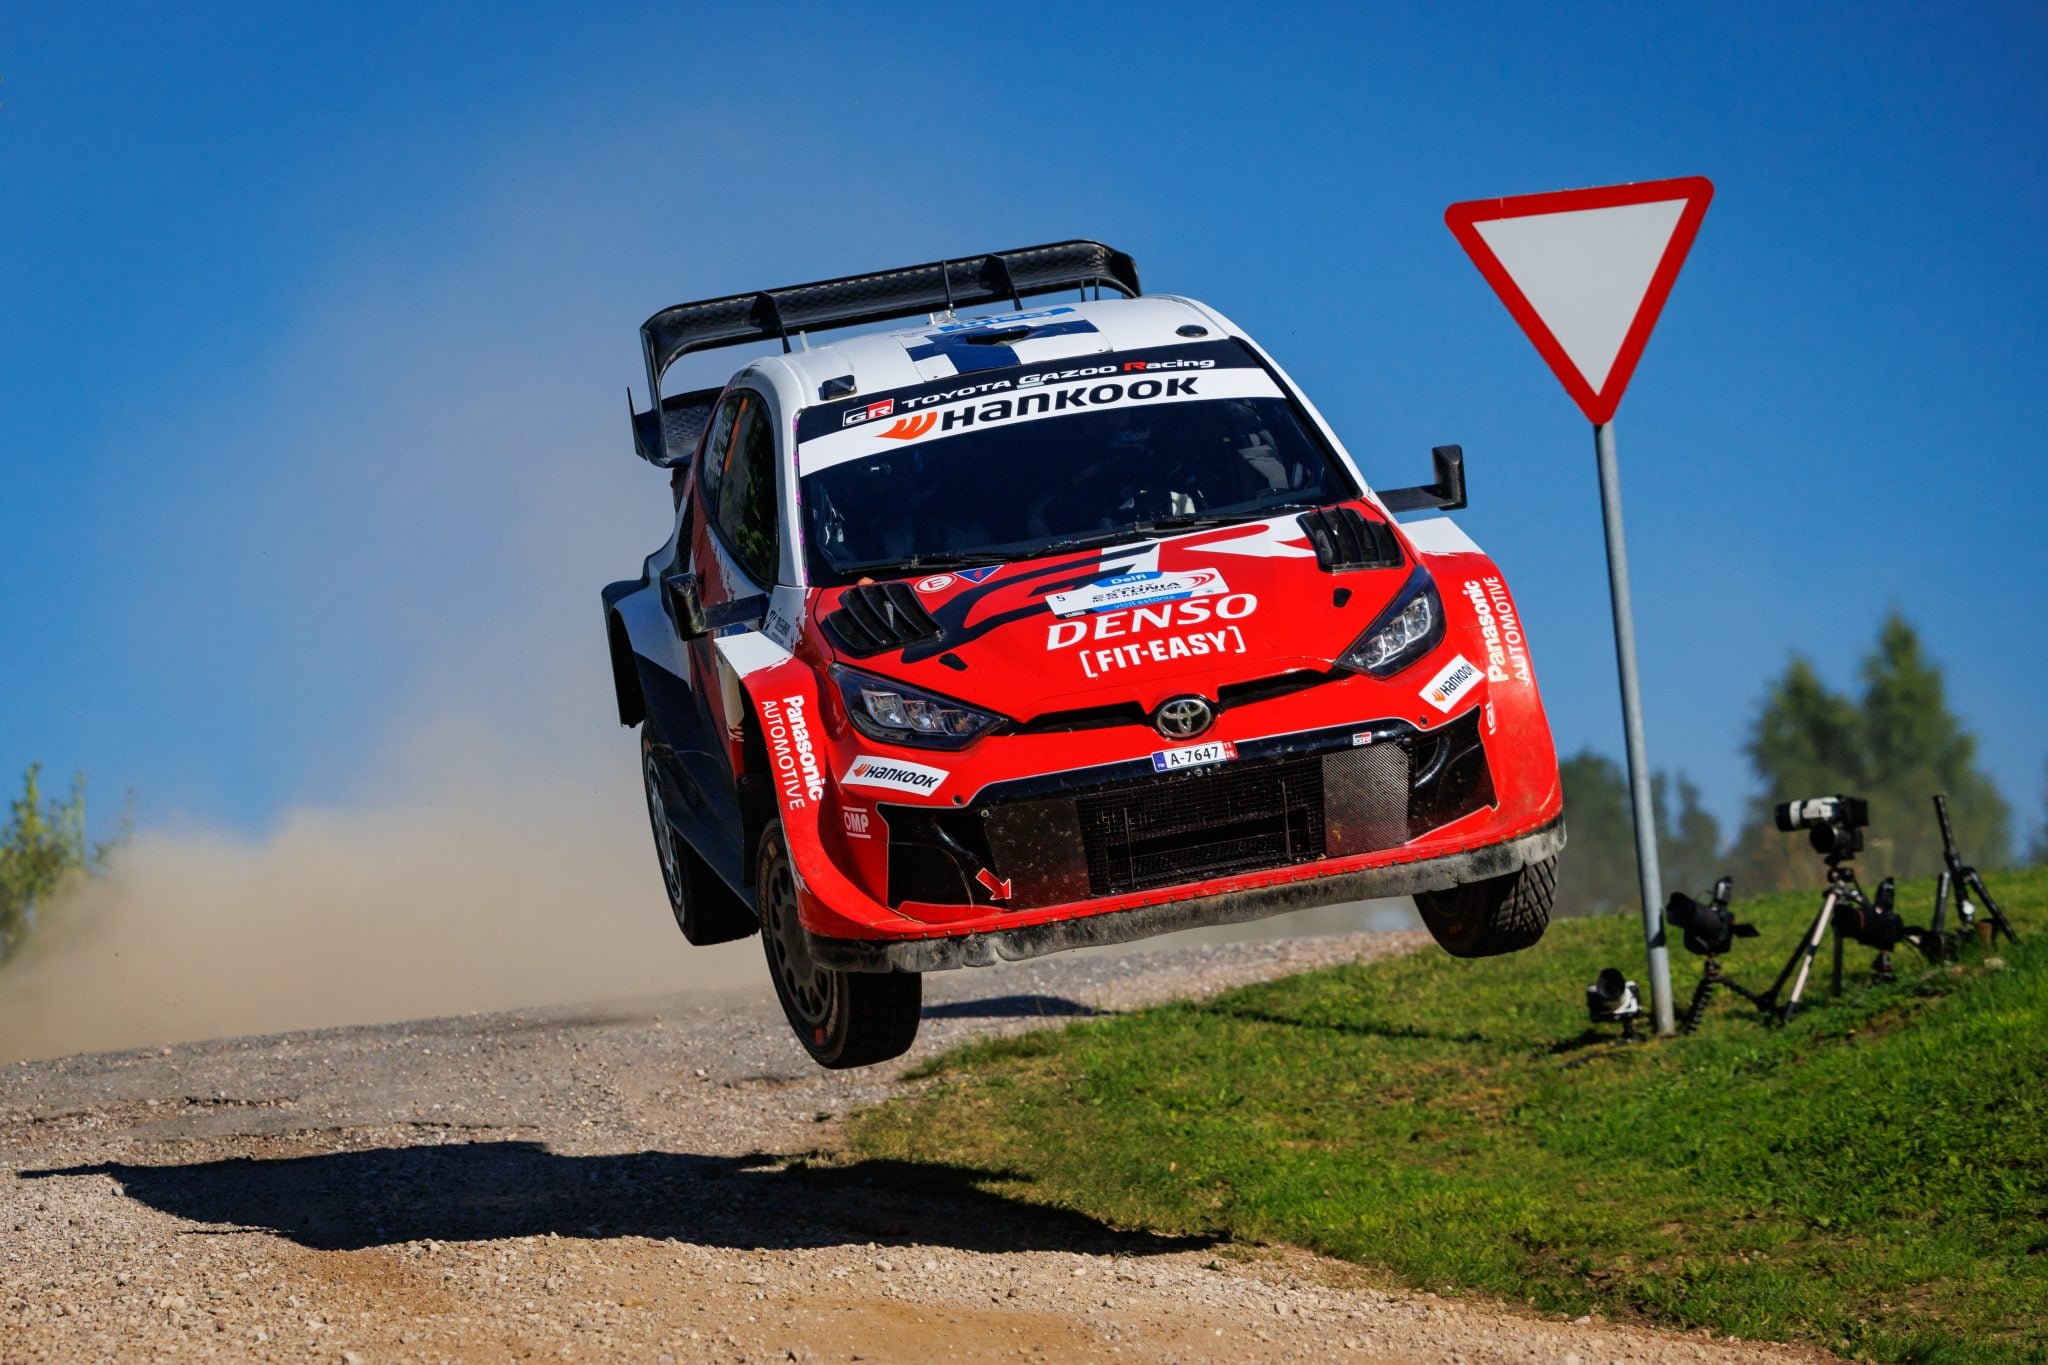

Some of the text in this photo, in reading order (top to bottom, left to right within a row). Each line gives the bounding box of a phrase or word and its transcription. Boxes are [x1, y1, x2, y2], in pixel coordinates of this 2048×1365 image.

[844, 358, 1216, 425] GR TOYOTA GAZOO Racing
[927, 578, 945, 589] E
[1055, 593, 1066, 603] 5
[1110, 573, 1147, 585] Delfi
[1136, 594, 1176, 606] estonia
[1046, 593, 1259, 652] DENSO
[1462, 579, 1510, 683] Panasonic
[1483, 576, 1531, 687] AUTOMOTIVE
[761, 700, 806, 810] AUTOMOTIVE
[782, 694, 826, 802] Panasonic
[1170, 746, 1219, 765] A-7647
[843, 811, 869, 833] OMP
